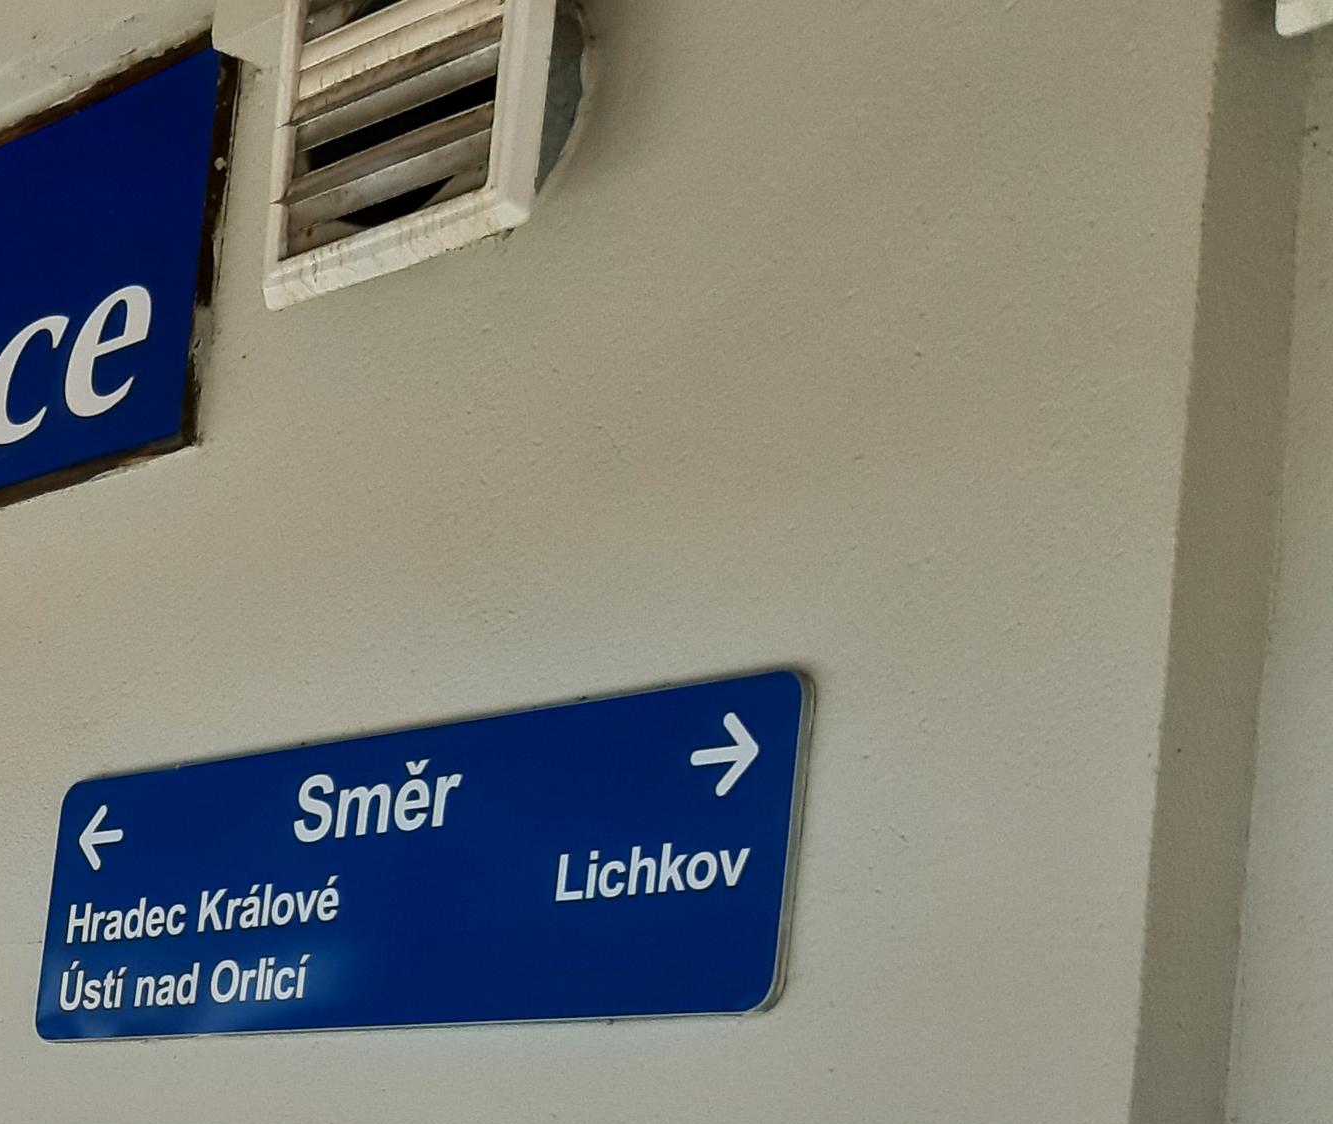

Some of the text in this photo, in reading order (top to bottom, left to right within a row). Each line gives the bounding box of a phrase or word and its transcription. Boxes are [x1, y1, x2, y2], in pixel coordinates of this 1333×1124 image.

[293, 759, 462, 844] Směr
[555, 843, 750, 902] Lichkov
[66, 875, 340, 944] Hradec Králové
[59, 954, 311, 1012] Ústí nad Orlicí
